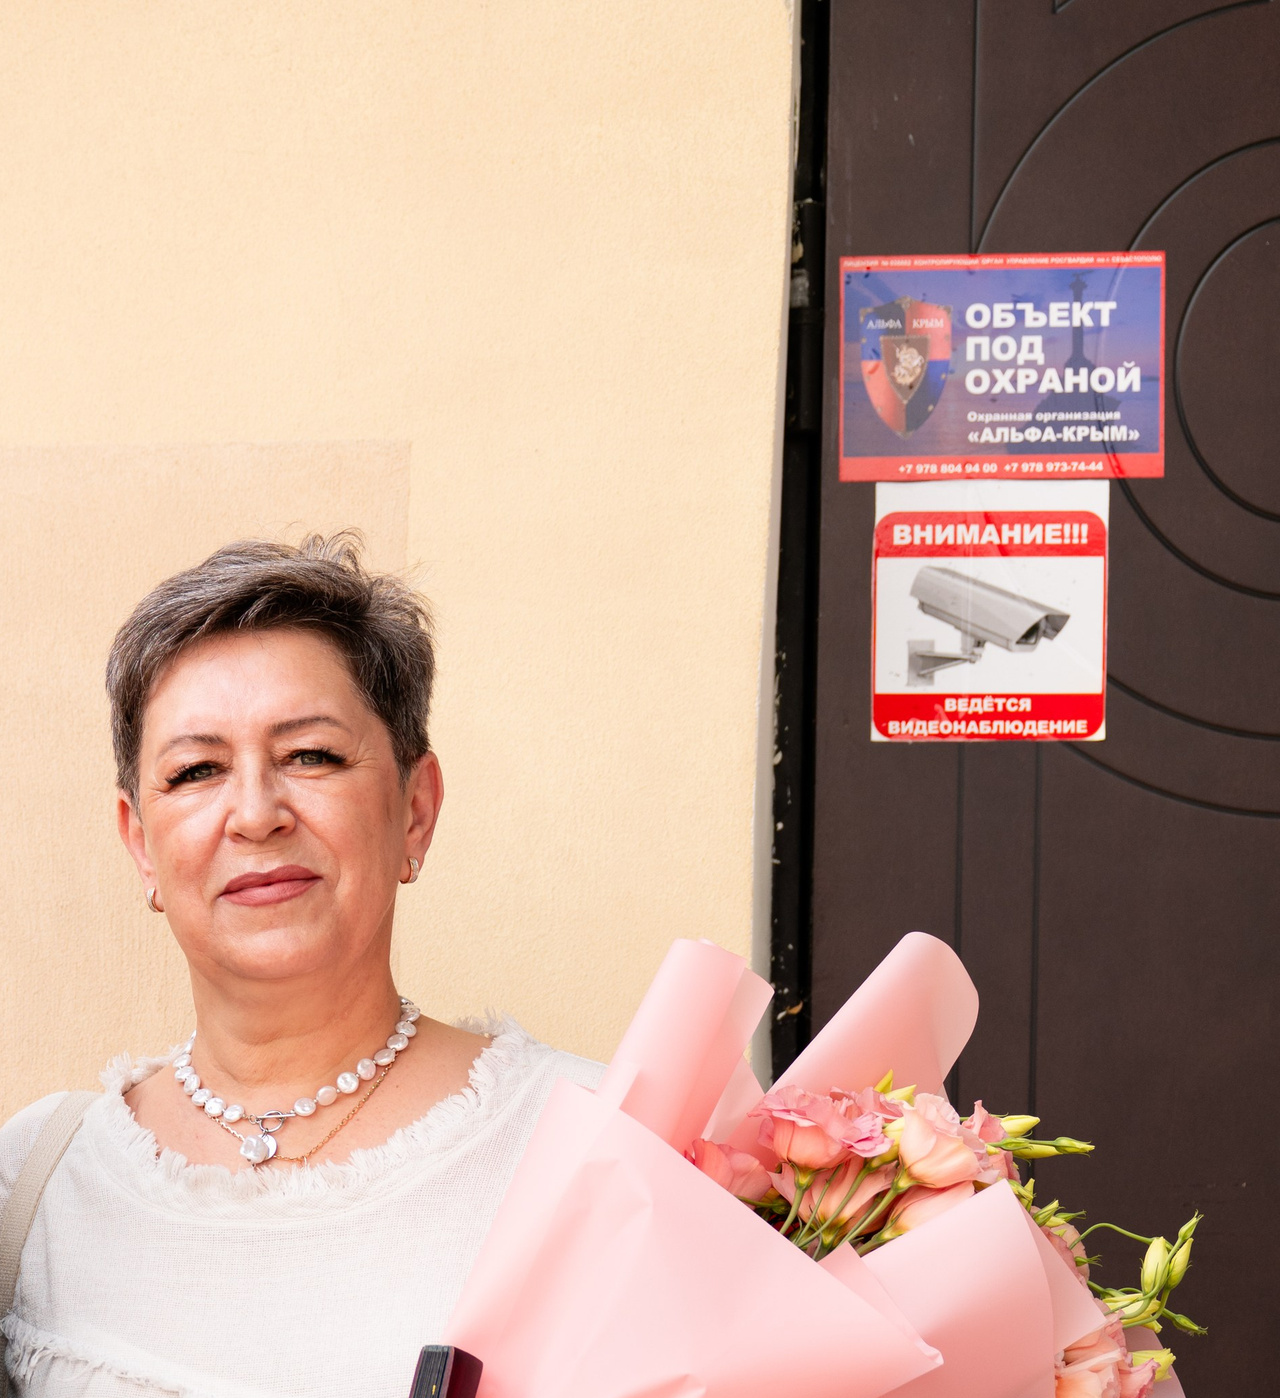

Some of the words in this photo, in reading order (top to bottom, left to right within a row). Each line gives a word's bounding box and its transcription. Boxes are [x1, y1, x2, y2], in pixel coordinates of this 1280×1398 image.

[866, 318, 903, 330] АЛЬФА
[912, 317, 945, 329] КРЫМ
[965, 301, 1117, 329] ОБЪЕКТ
[965, 335, 1045, 365] ПОД
[965, 361, 1142, 395] ОХРАНОЙ
[967, 411, 1033, 423] Охранная
[1035, 410, 1122, 423] организация
[967, 425, 1140, 443] «АЛЬФА-КРЫМ»
[898, 464, 913, 474] +7
[916, 463, 937, 474] 978
[940, 463, 962, 474] 804
[982, 463, 998, 473] 00
[1004, 462, 1018, 472] +7
[1021, 462, 1044, 472] 978
[1046, 461, 1104, 472] 973-74-44
[893, 523, 1089, 545] ВНИМАНИЕ!!!
[944, 696, 1032, 714] ВЕДЁТСЯ
[888, 719, 1088, 736] ВИДЕОНАБЛЮДЕНИЕ
